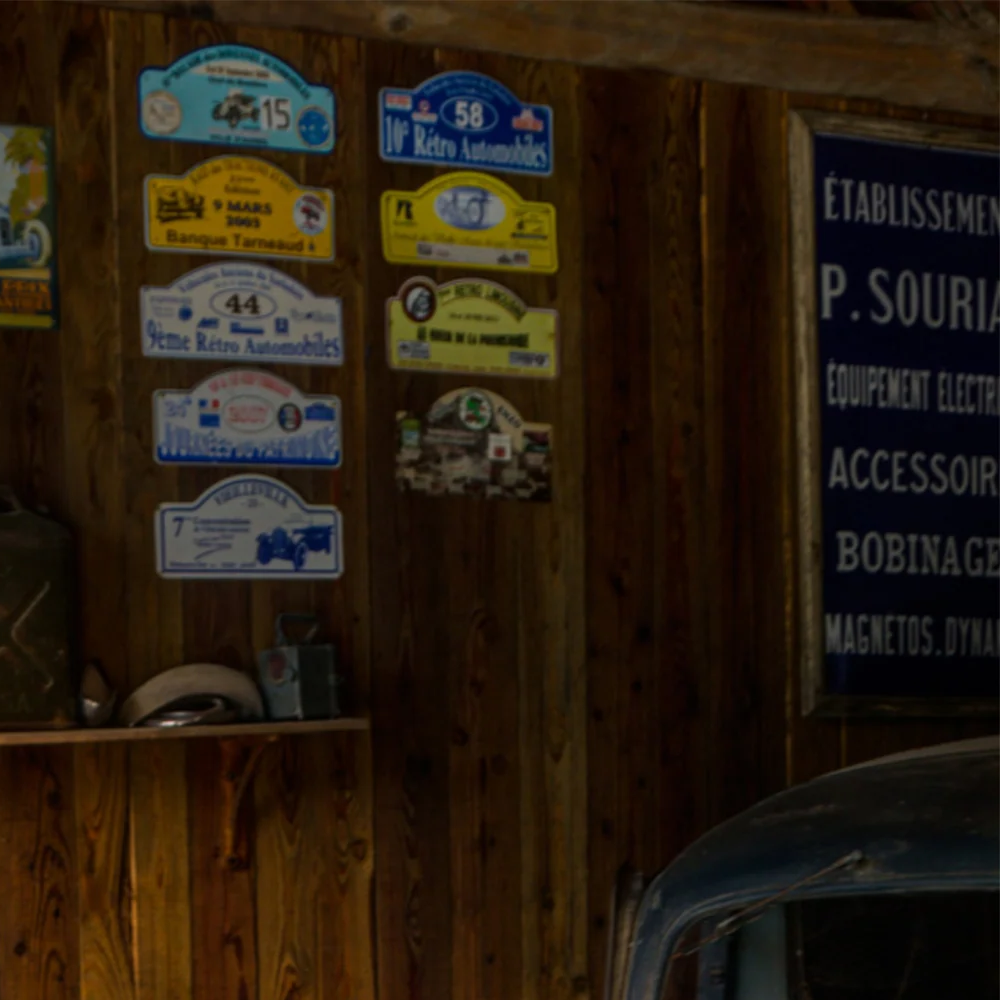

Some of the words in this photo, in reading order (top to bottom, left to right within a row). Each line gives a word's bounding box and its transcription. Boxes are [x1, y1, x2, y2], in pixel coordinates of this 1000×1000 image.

[262, 98, 290, 130] 15
[455, 100, 485, 129] 58
[413, 123, 458, 158] Rétro
[227, 200, 272, 216] MARS
[167, 229, 228, 249] Banque
[224, 293, 260, 315] 44
[196, 331, 239, 353] Rétro
[828, 447, 999, 497] ACCESSOIR
[836, 530, 1000, 578] BOBINAGE
